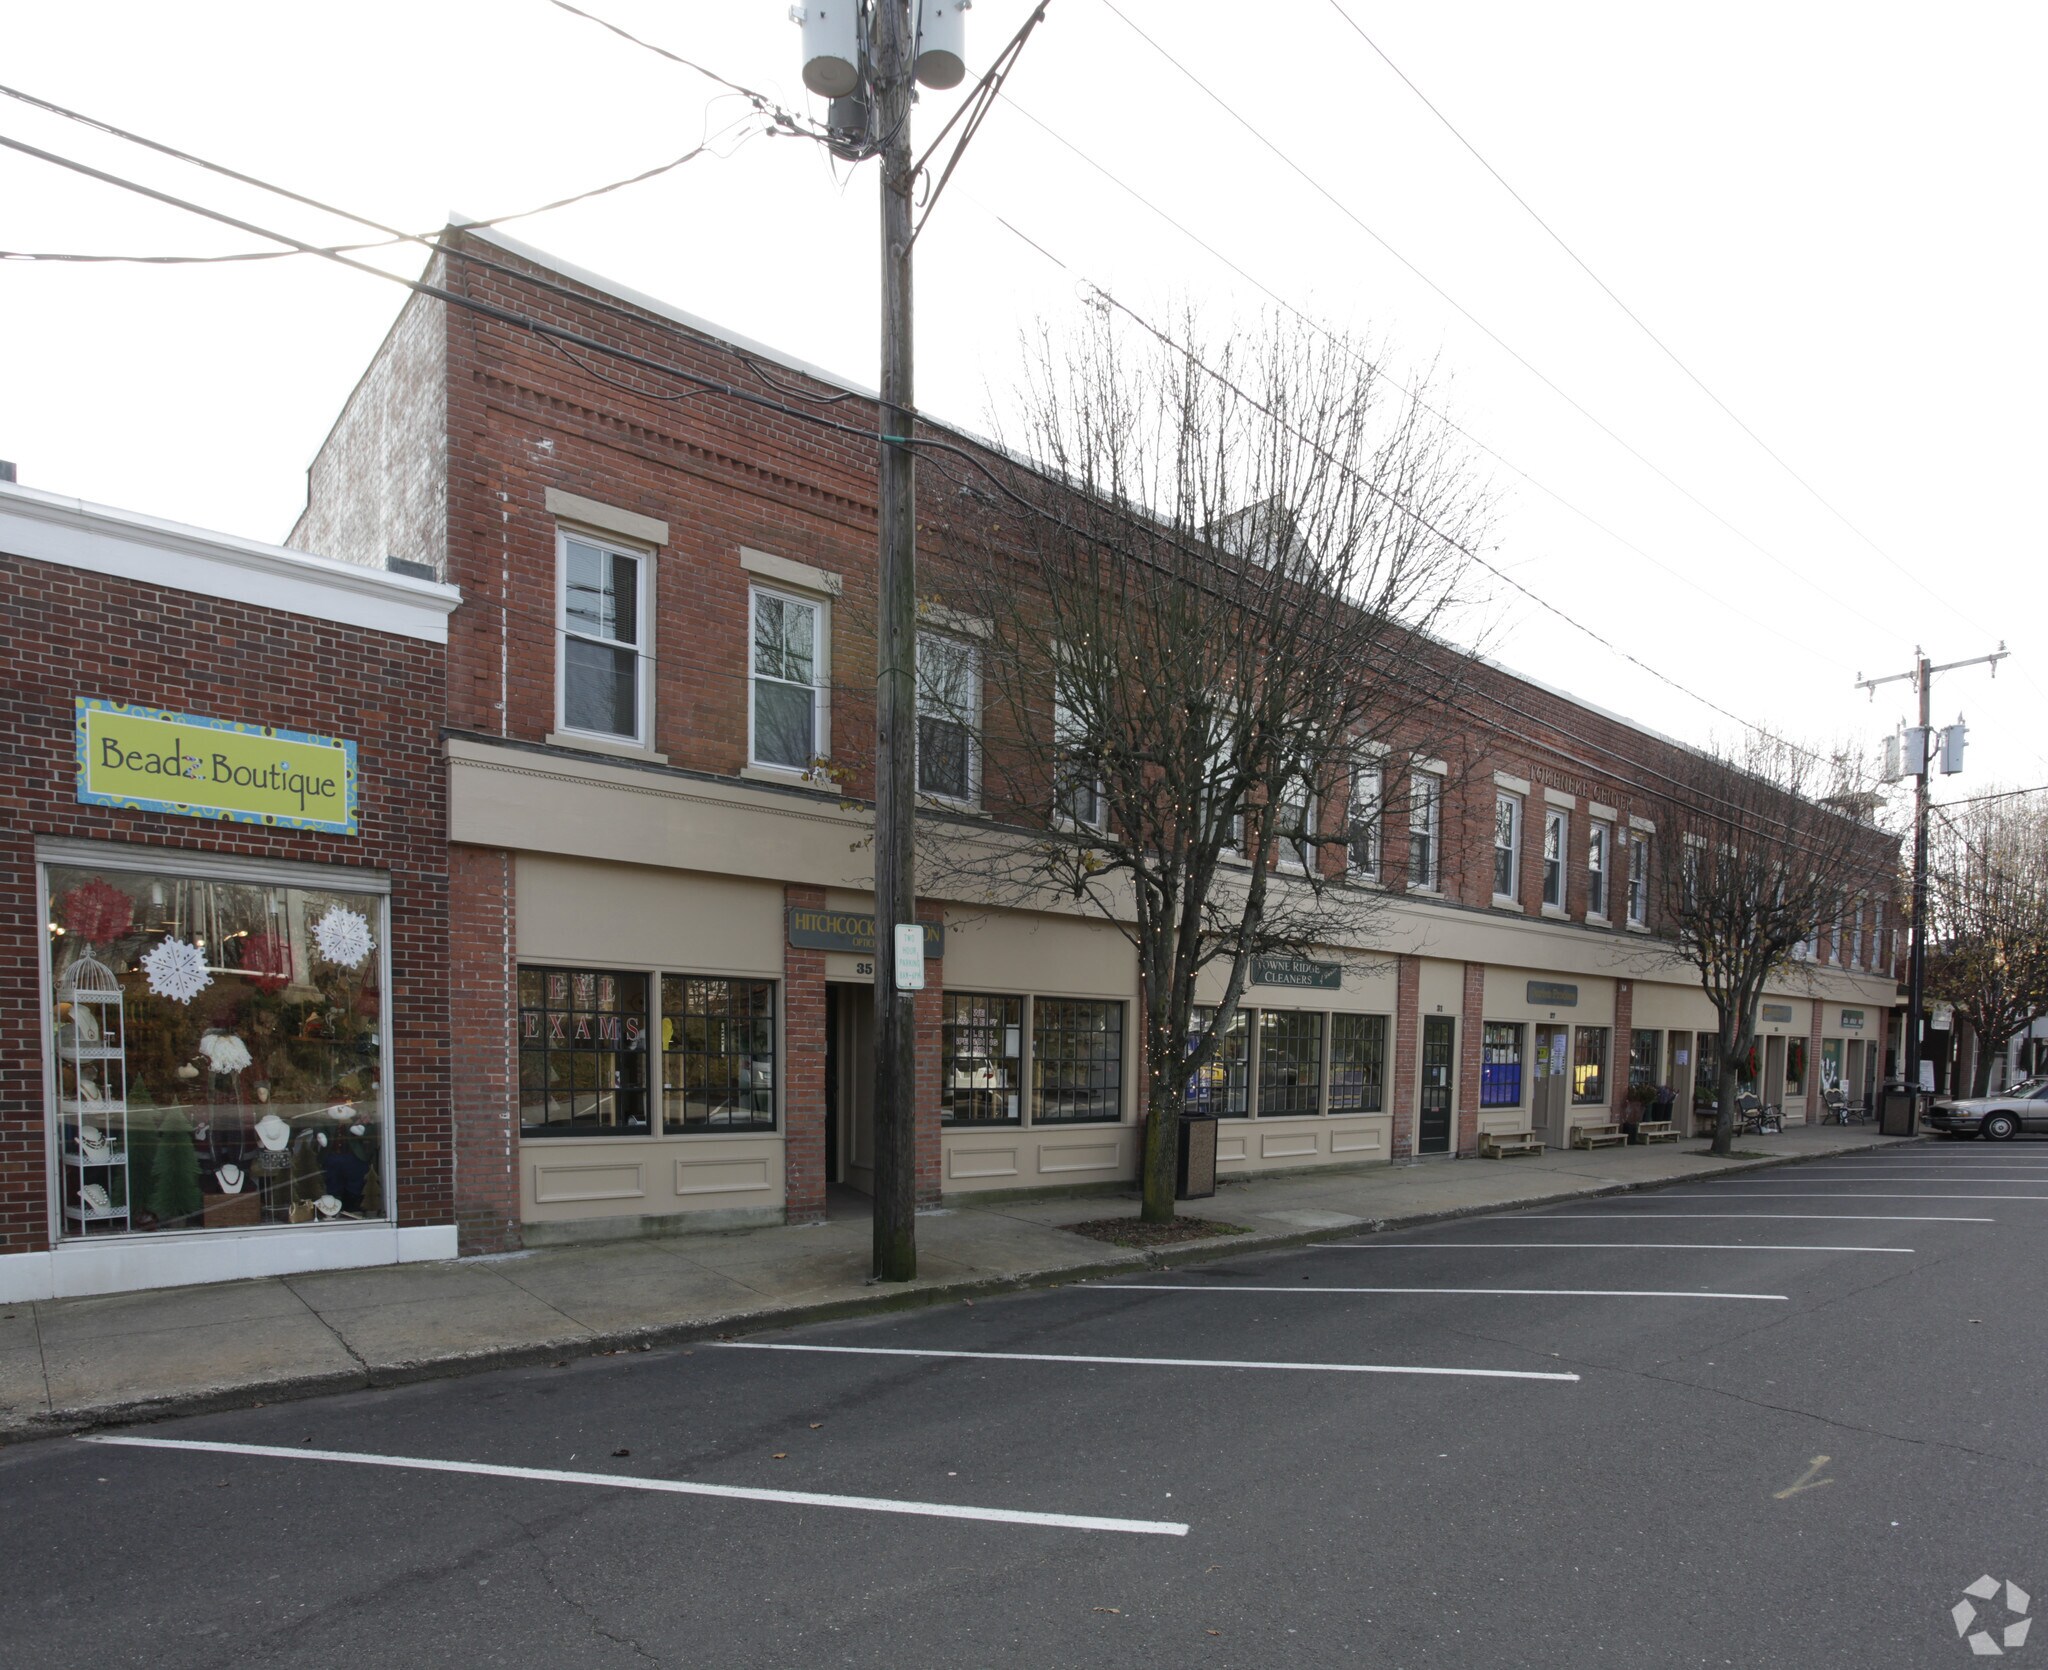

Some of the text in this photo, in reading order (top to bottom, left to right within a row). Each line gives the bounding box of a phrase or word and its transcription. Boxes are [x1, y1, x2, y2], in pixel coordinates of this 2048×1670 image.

[101, 737, 336, 811] Beadz Boutique
[903, 933, 915, 942] TWO
[902, 946, 917, 955] HOUR
[856, 963, 873, 975] 35
[900, 958, 920, 967] PARKING
[1292, 961, 1320, 974] RIDGE
[1264, 971, 1312, 985] CLEANERS
[549, 975, 616, 1002] EYE
[523, 1012, 639, 1041] EXAMS
